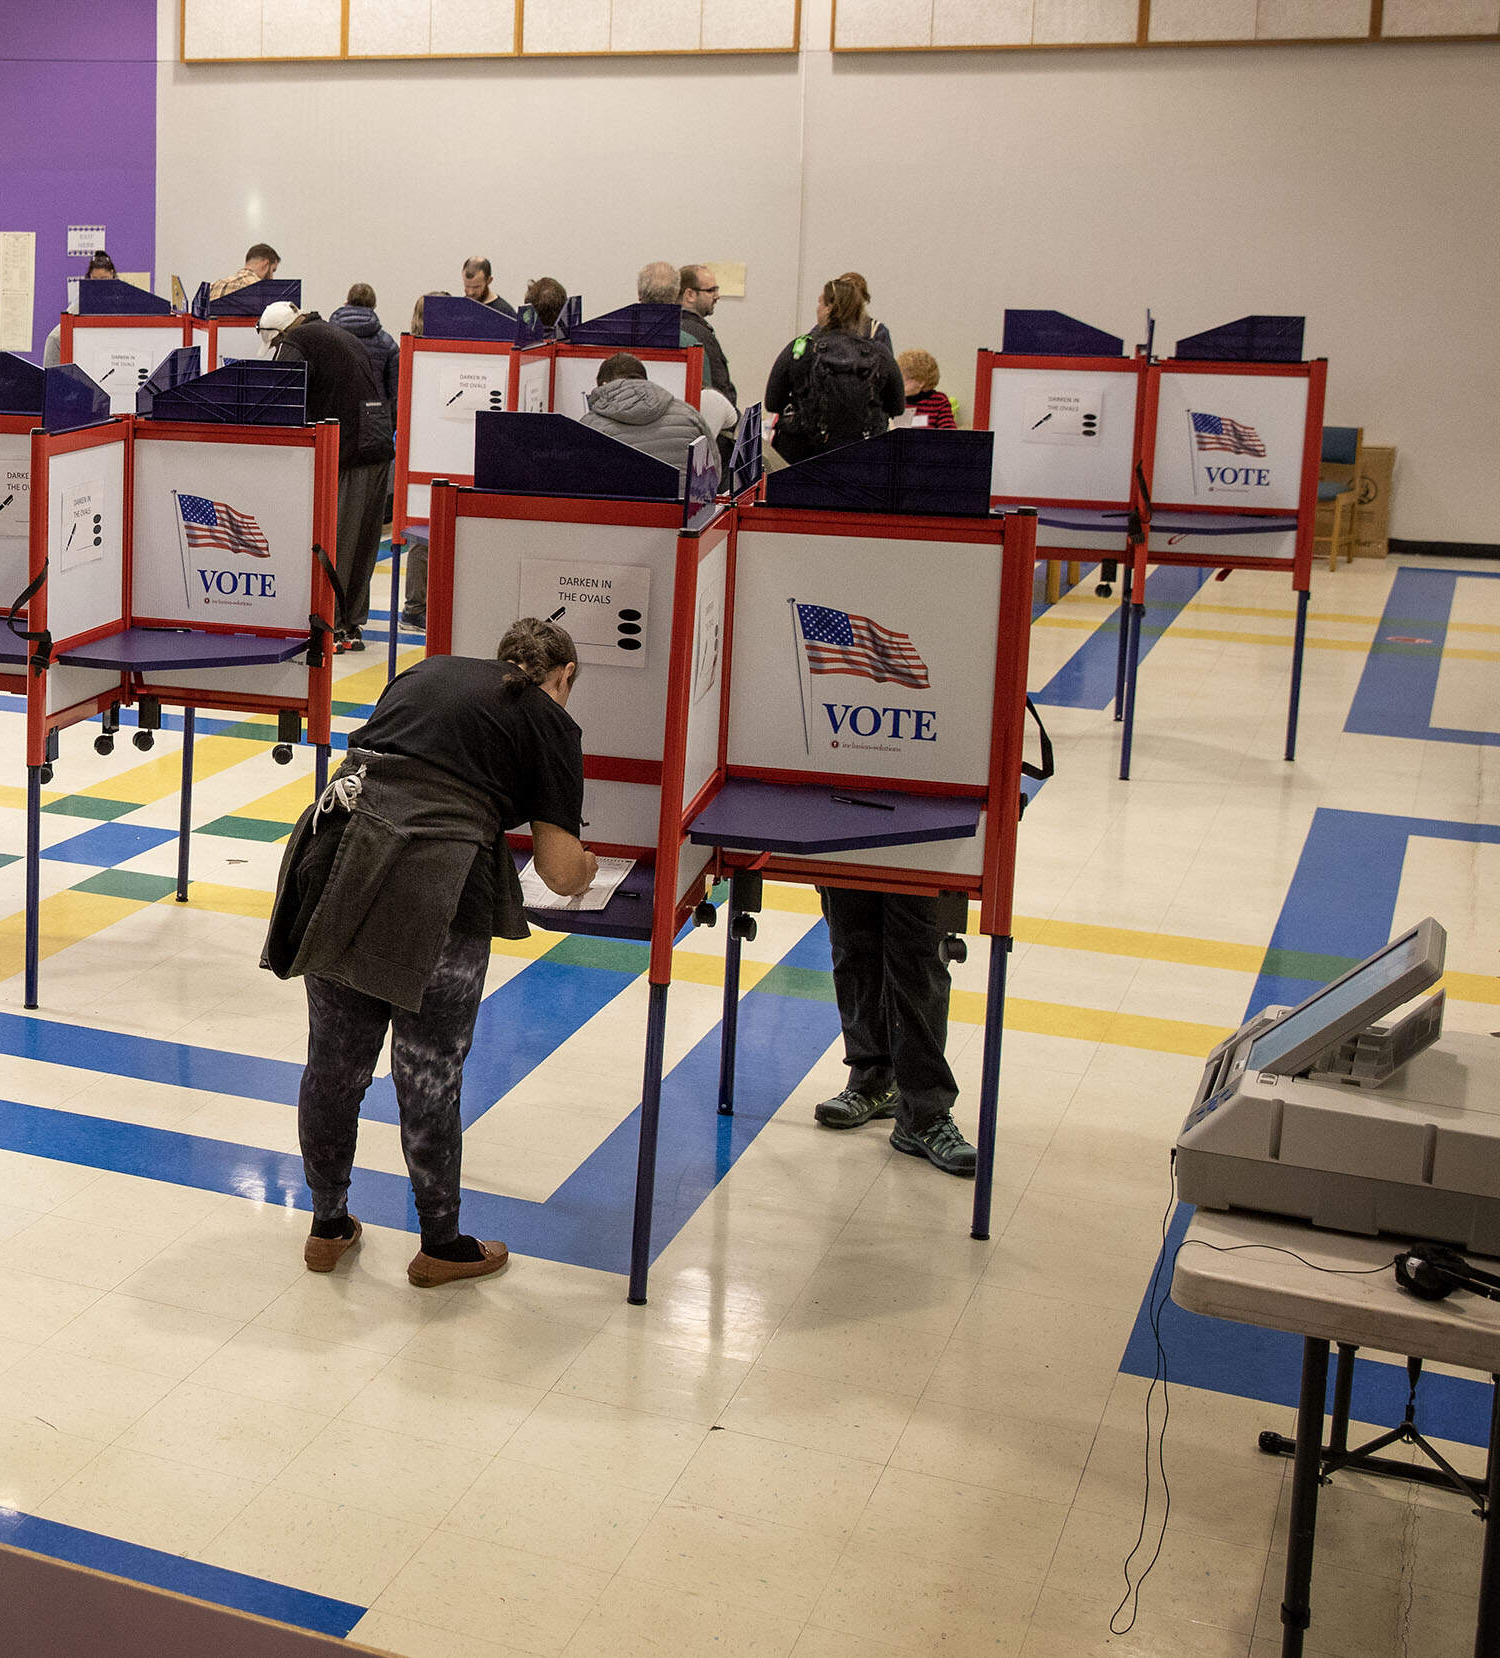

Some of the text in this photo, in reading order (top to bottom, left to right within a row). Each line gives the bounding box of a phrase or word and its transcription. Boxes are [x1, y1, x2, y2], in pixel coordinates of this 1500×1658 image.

[1204, 467, 1270, 486] VOTE
[197, 569, 276, 597] VOTE
[559, 576, 612, 588] DARKEN IN
[558, 592, 611, 604] THE OVALS
[822, 703, 937, 741] VOTE
